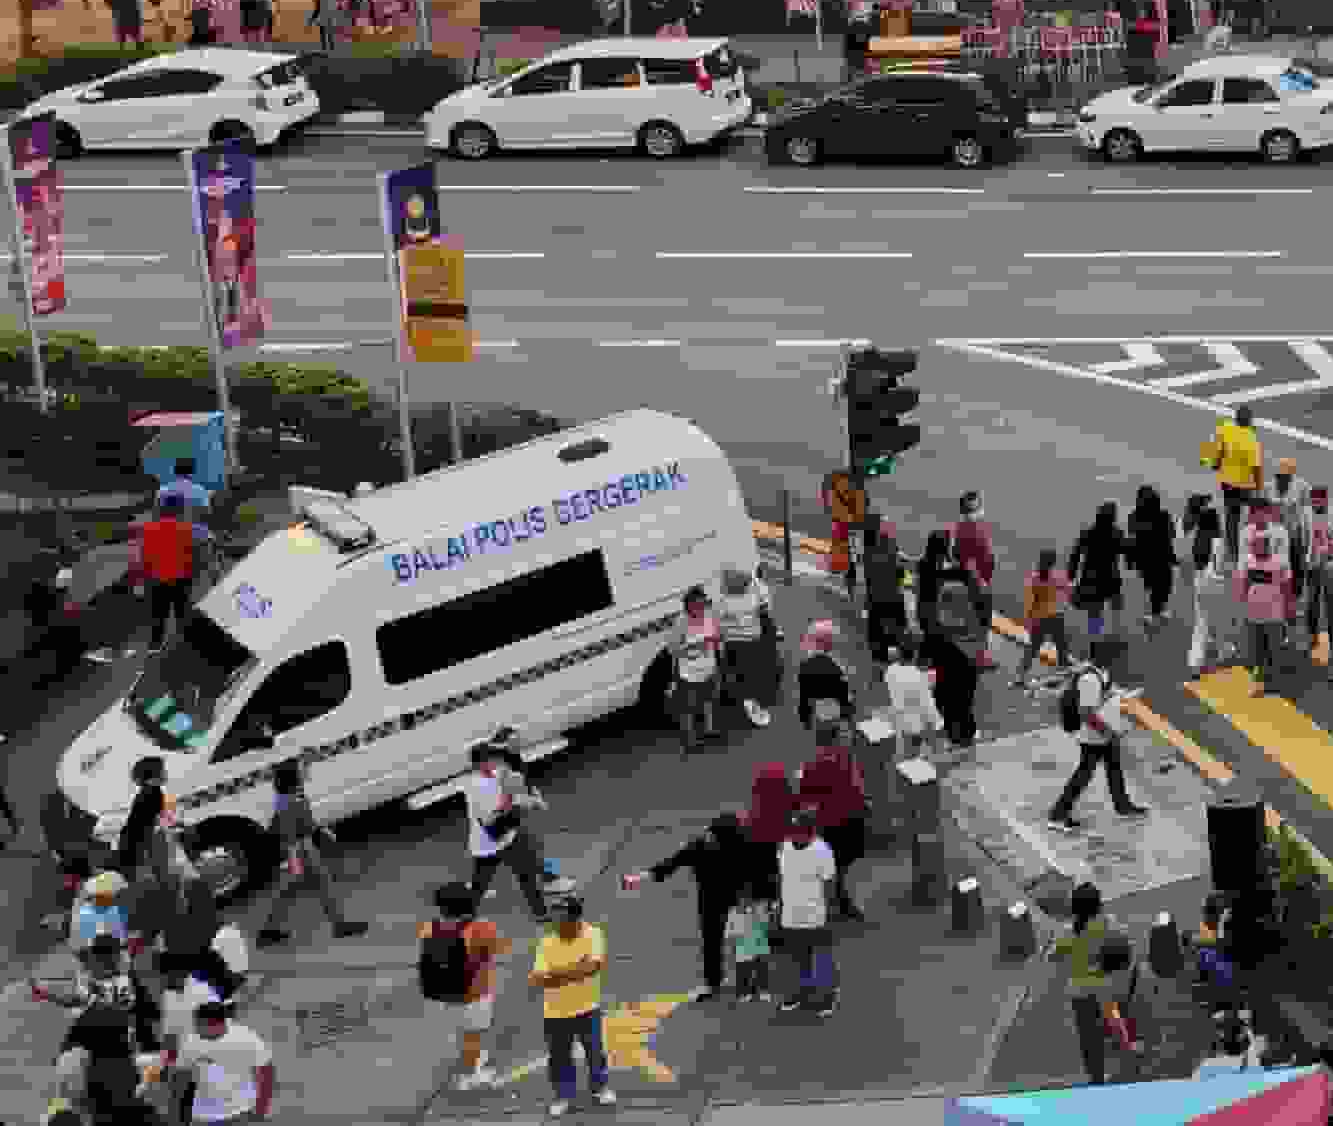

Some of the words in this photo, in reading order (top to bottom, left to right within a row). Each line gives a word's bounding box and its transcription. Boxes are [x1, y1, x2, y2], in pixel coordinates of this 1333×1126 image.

[392, 532, 471, 586] BALAI
[471, 505, 546, 558] POLIS
[552, 460, 689, 524] BERGERAK
